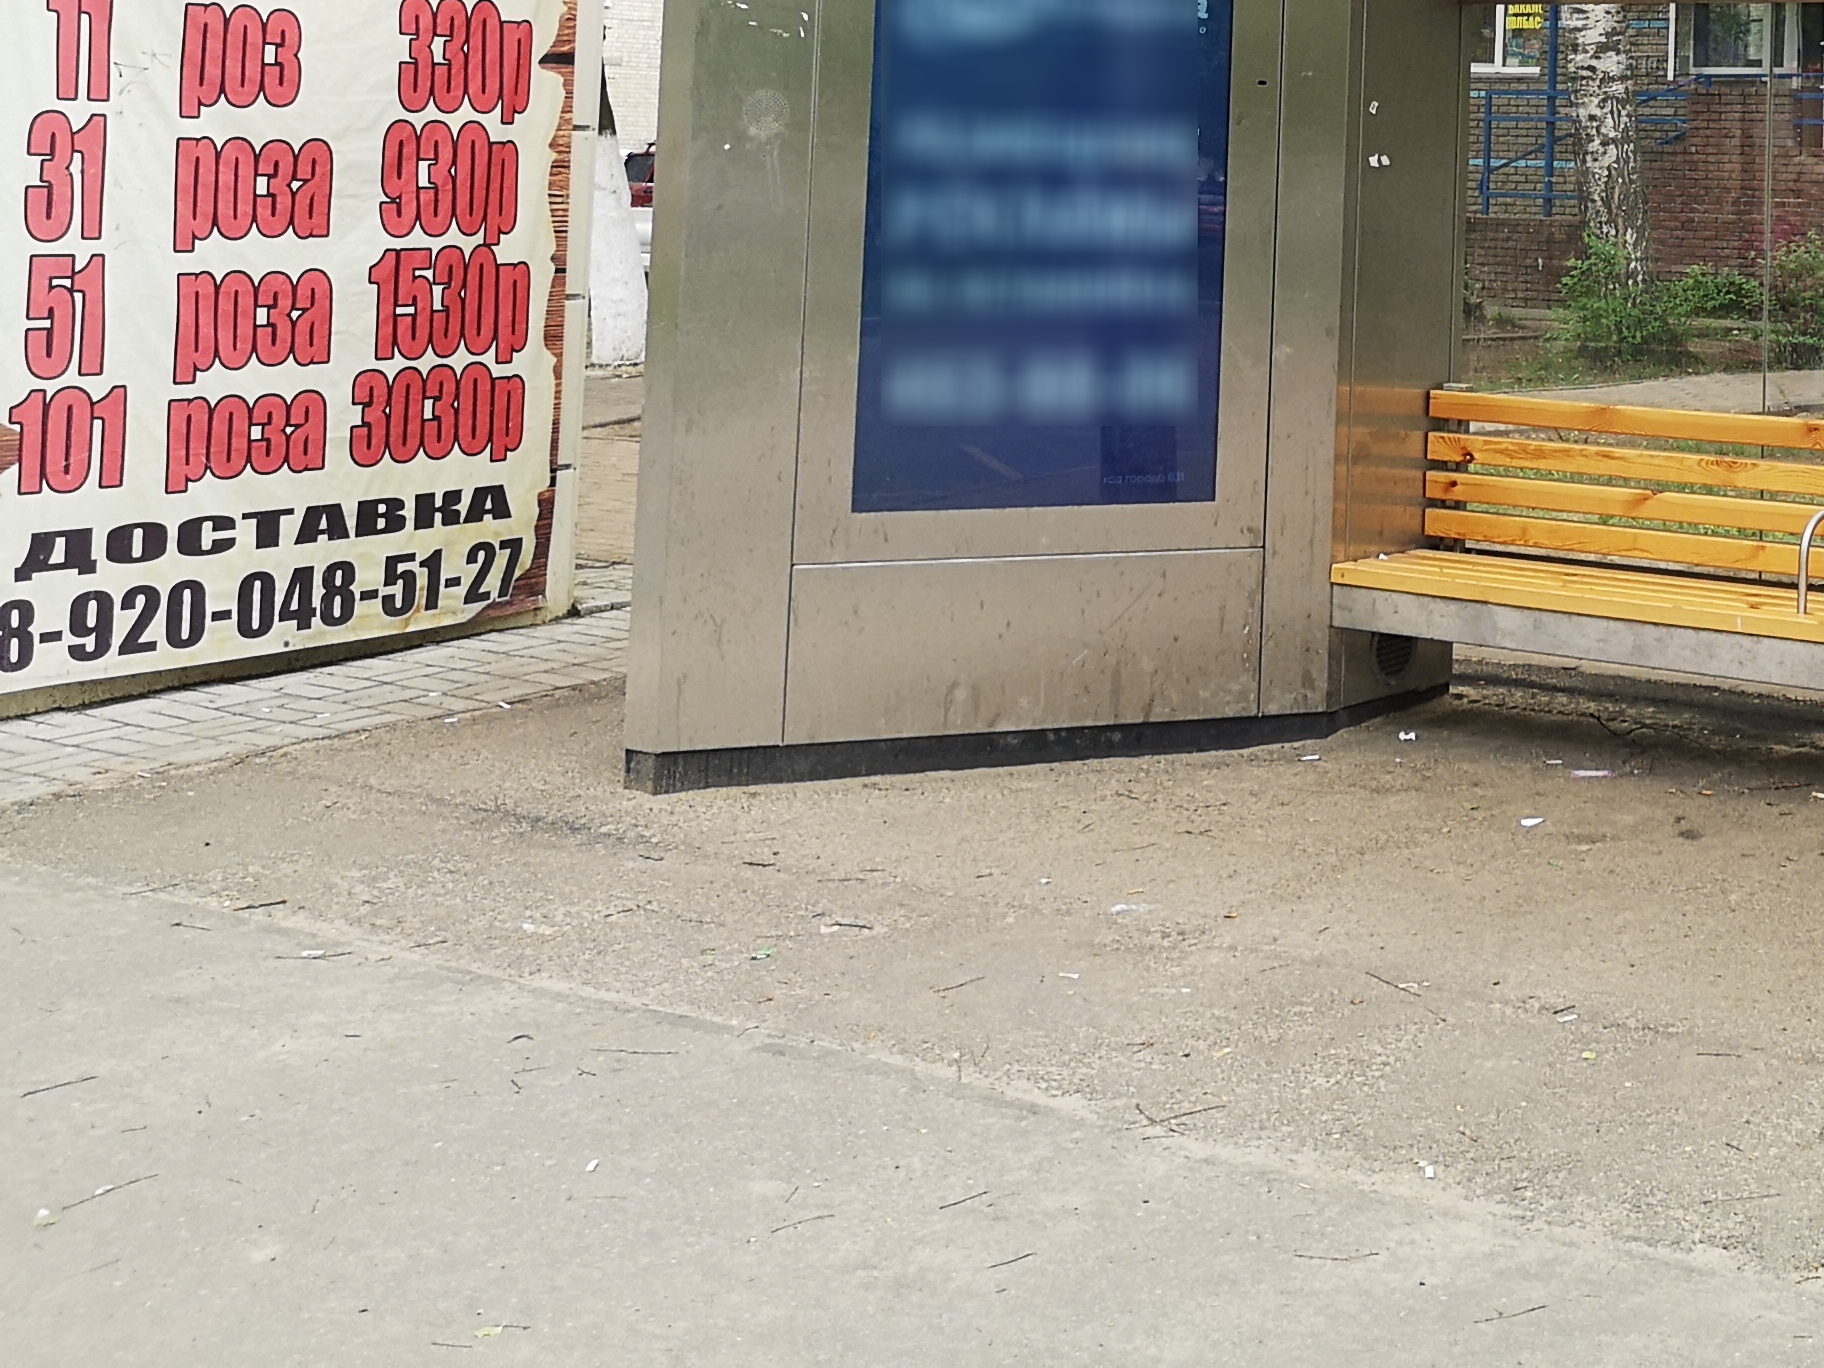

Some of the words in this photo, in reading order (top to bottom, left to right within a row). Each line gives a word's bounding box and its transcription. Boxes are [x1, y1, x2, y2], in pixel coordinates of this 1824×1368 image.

[179, 2, 302, 119] роз
[24, 109, 107, 242] 31
[173, 136, 334, 253] роза
[379, 119, 520, 245] 930р
[24, 253, 105, 380] 51
[173, 269, 334, 385] роза
[367, 245, 531, 364] 1530р
[9, 384, 127, 495] 101
[165, 389, 327, 494] роза
[349, 361, 526, 466] 3030р
[14, 484, 513, 583] ДОСТАВКА
[0, 537, 524, 673] 8-920-048-51-27
